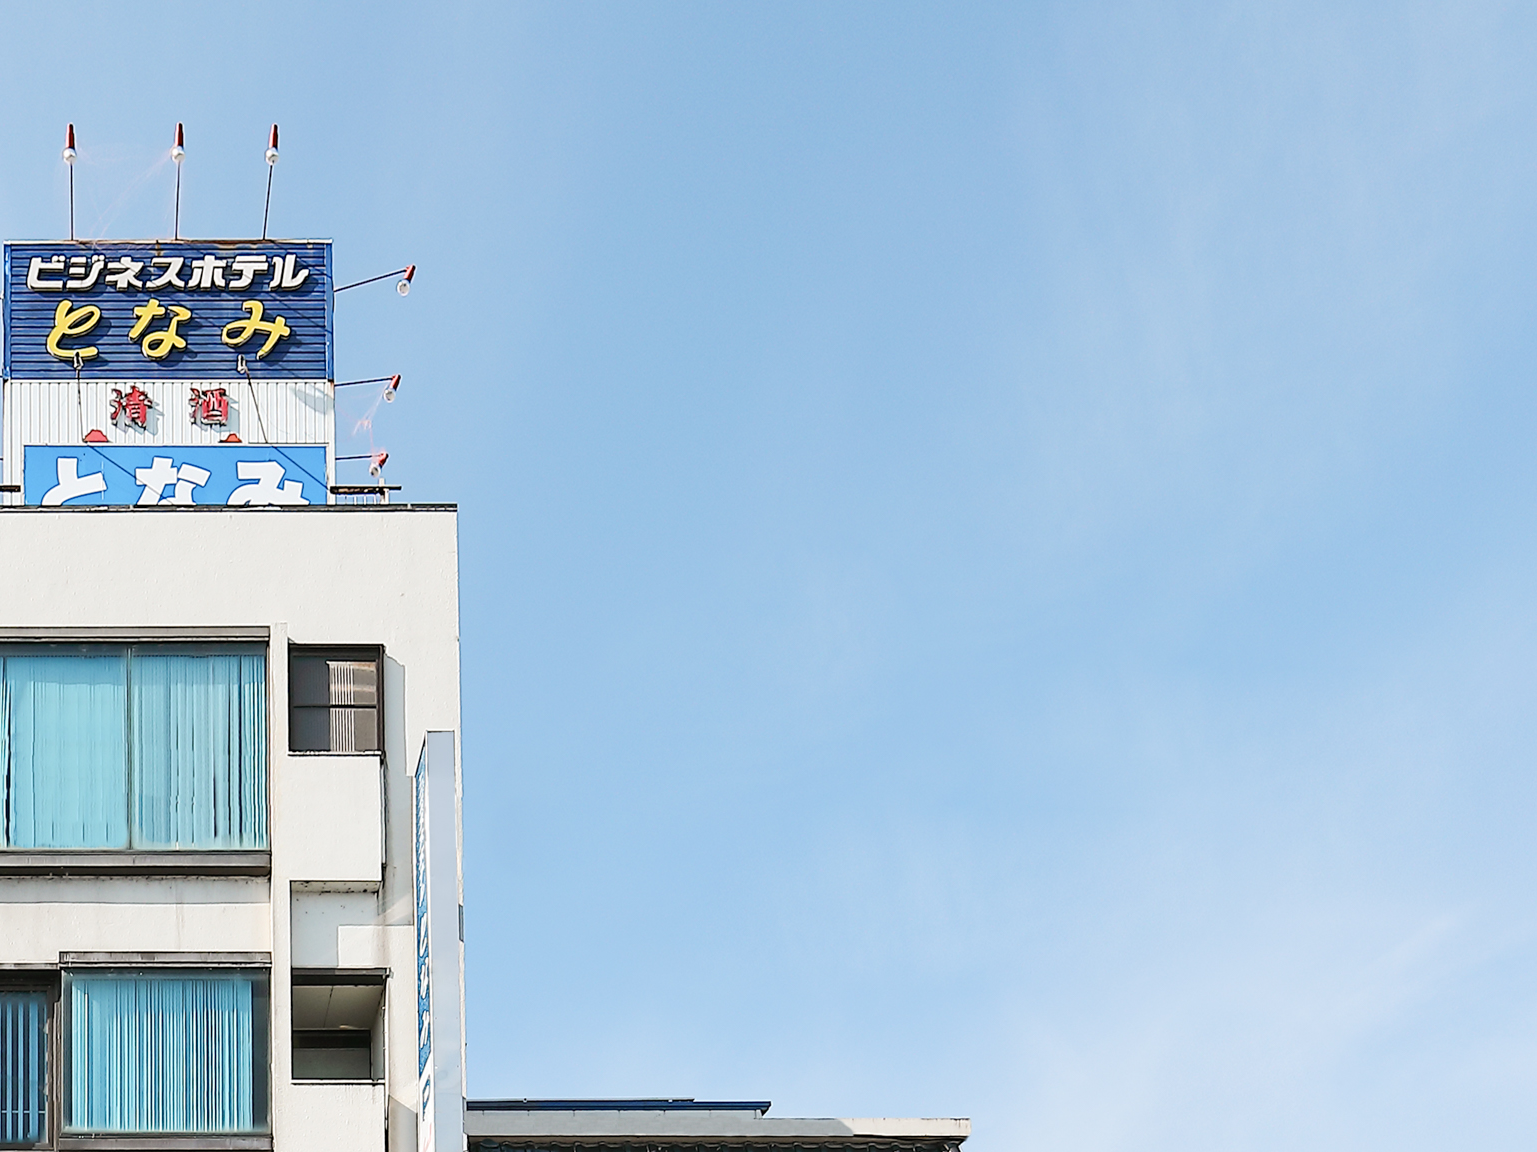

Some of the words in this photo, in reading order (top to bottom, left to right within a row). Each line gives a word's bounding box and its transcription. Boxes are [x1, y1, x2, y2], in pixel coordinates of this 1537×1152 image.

[26, 255, 309, 290] ビジネスホテル
[46, 299, 291, 360] となみ
[110, 386, 229, 427] 清酒
[41, 456, 310, 506] となみ
